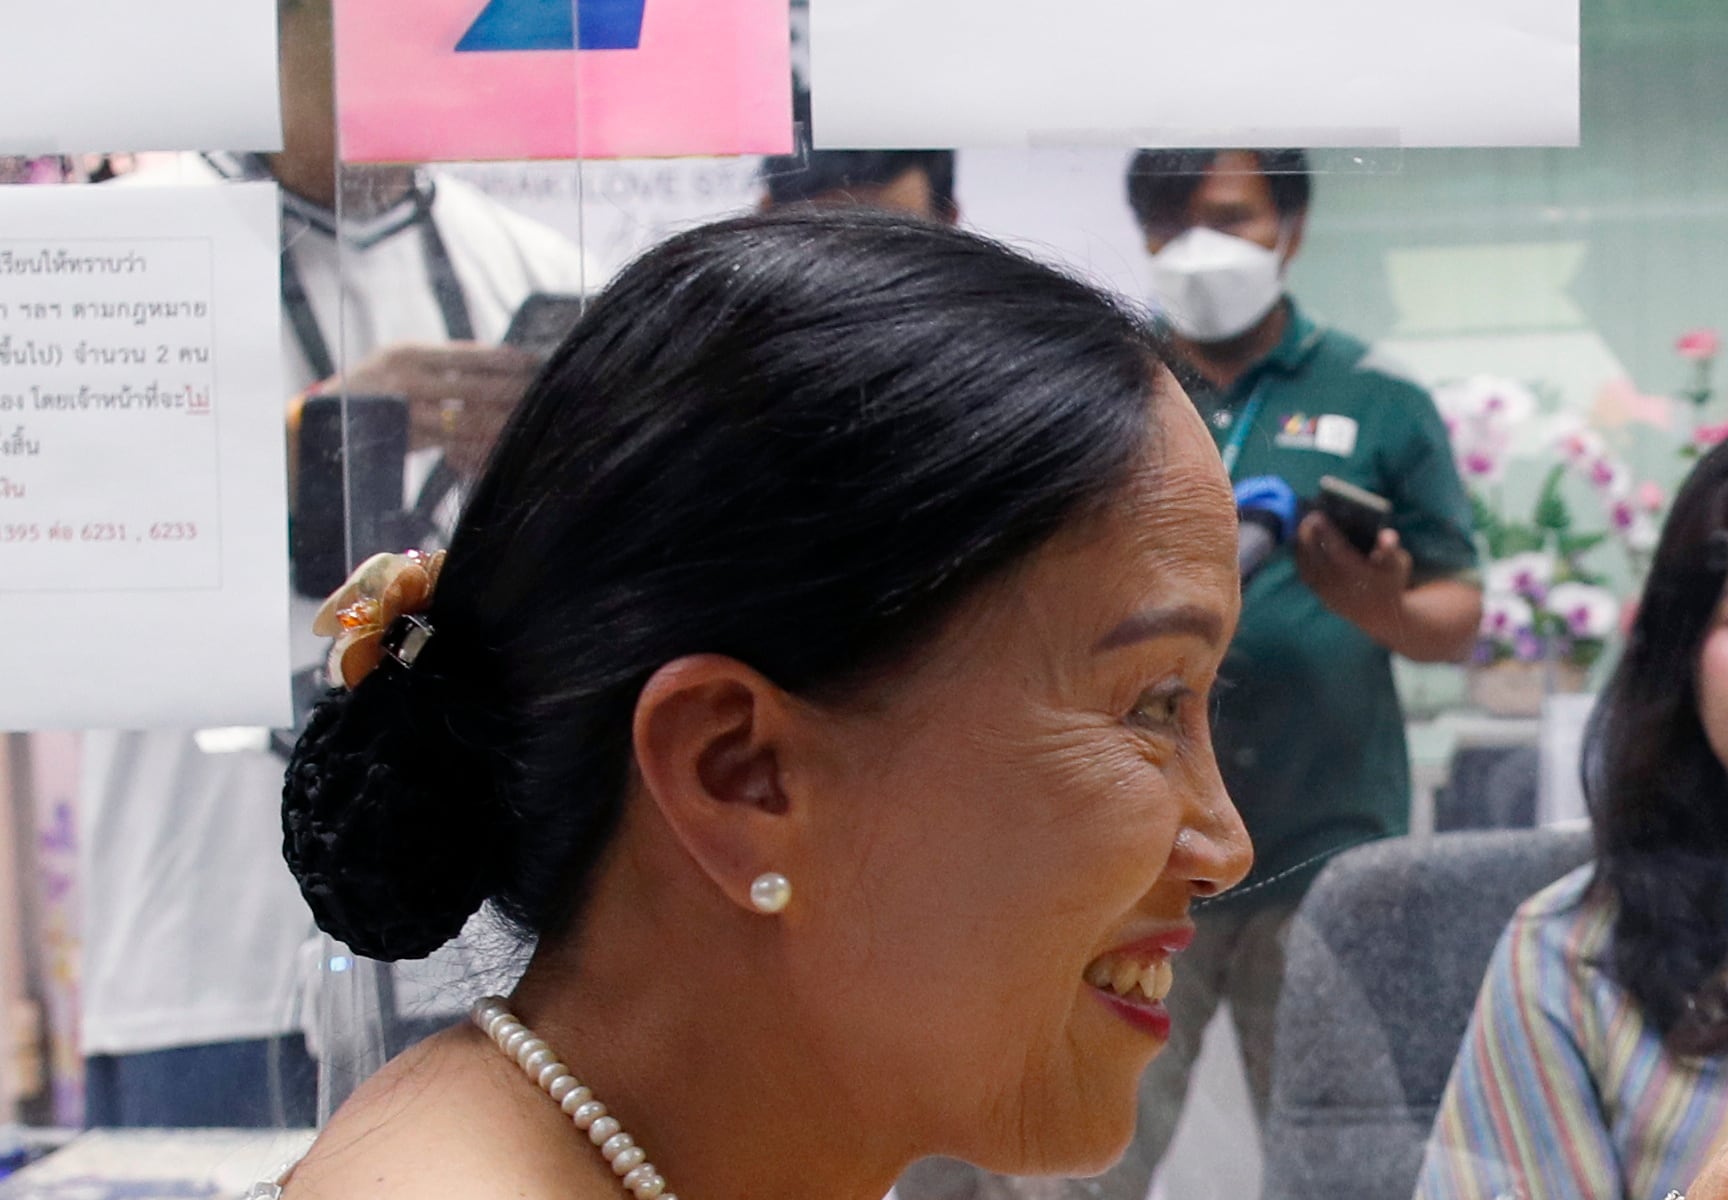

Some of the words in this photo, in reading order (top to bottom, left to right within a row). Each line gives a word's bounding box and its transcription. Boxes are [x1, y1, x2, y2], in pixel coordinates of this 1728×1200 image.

[73, 301, 207, 325] ตามกฎหมาย
[74, 340, 146, 364] จำนวน
[157, 345, 169, 363] 2
[178, 346, 209, 363] คน
[81, 523, 126, 541] 6231
[149, 523, 198, 540] 6233
